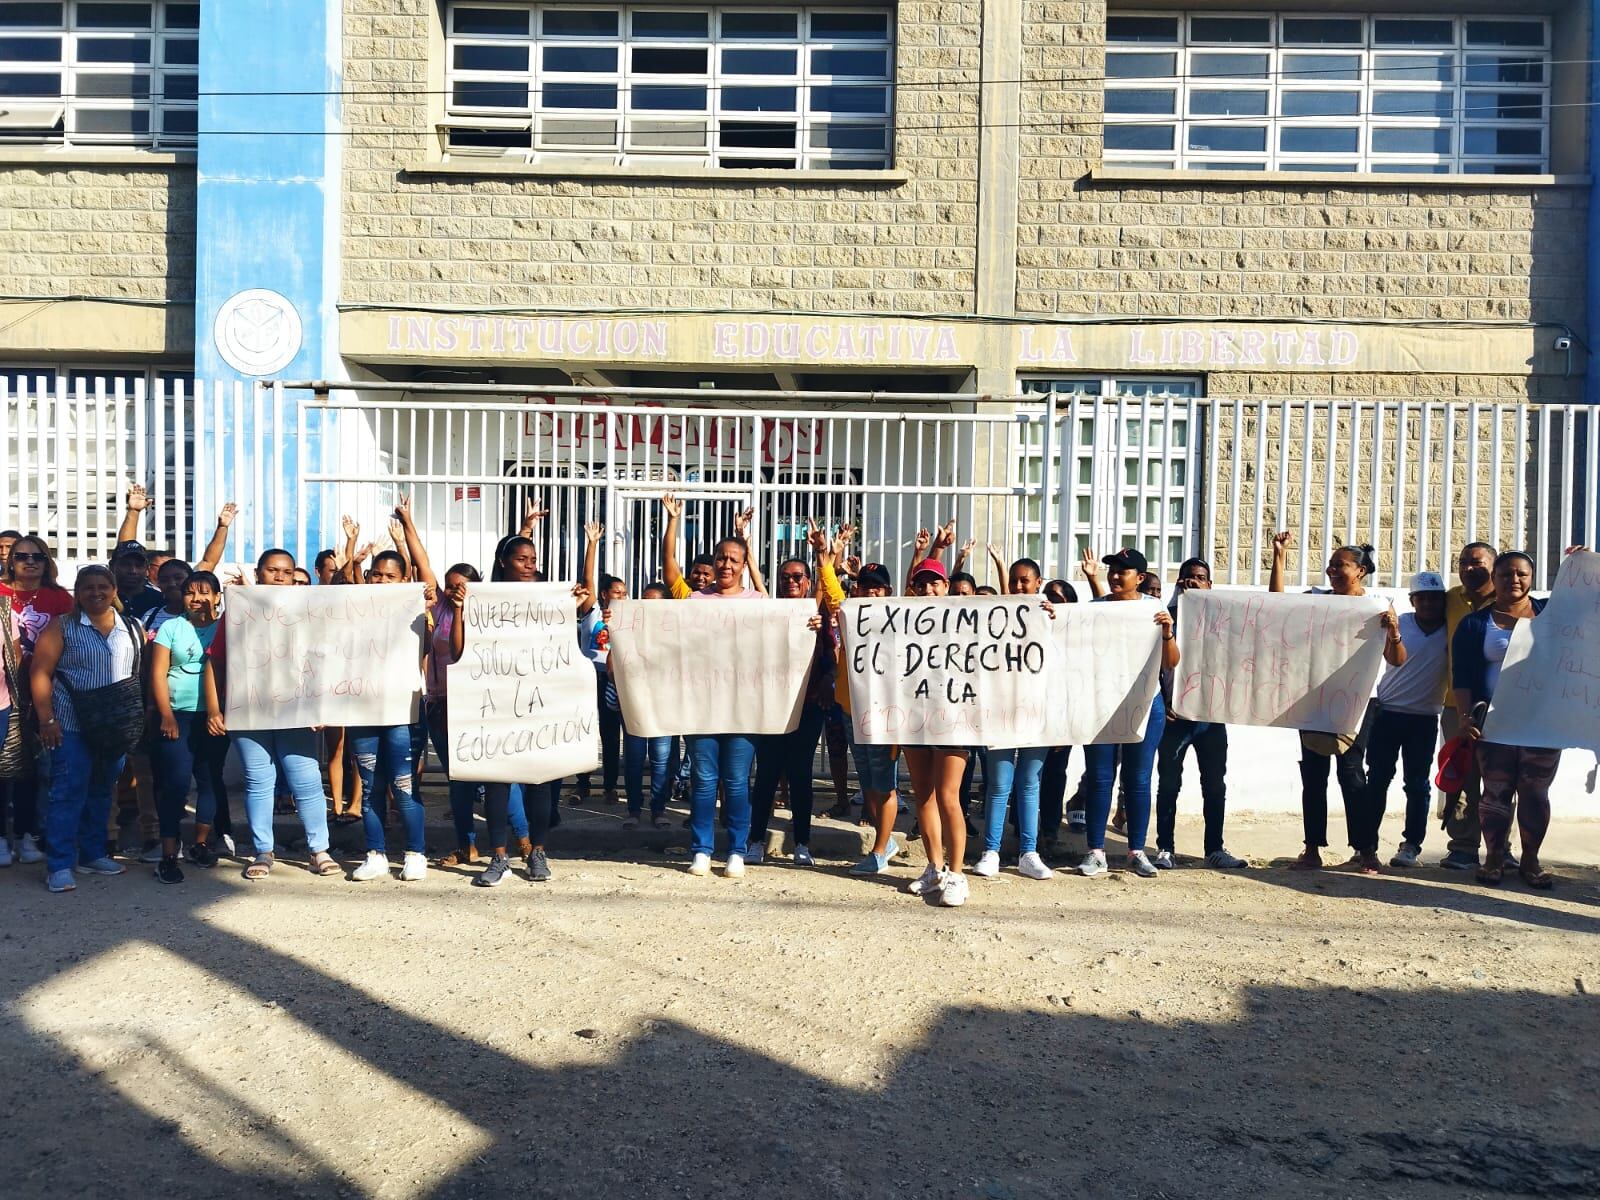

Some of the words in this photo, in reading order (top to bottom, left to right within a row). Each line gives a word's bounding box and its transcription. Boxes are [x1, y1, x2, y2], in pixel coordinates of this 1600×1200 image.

[387, 314, 667, 357] INSTITUCION
[713, 321, 961, 362] EDUCATIVA
[1018, 326, 1077, 363] LA
[1129, 327, 1359, 366] LIBERTAD
[856, 603, 1030, 640] EXIGIMOS
[853, 642, 885, 674] EL
[903, 641, 1045, 677] DERECHO
[480, 688, 497, 718] A
[513, 680, 544, 718] LA
[914, 678, 929, 700] A
[946, 678, 977, 704] LA
